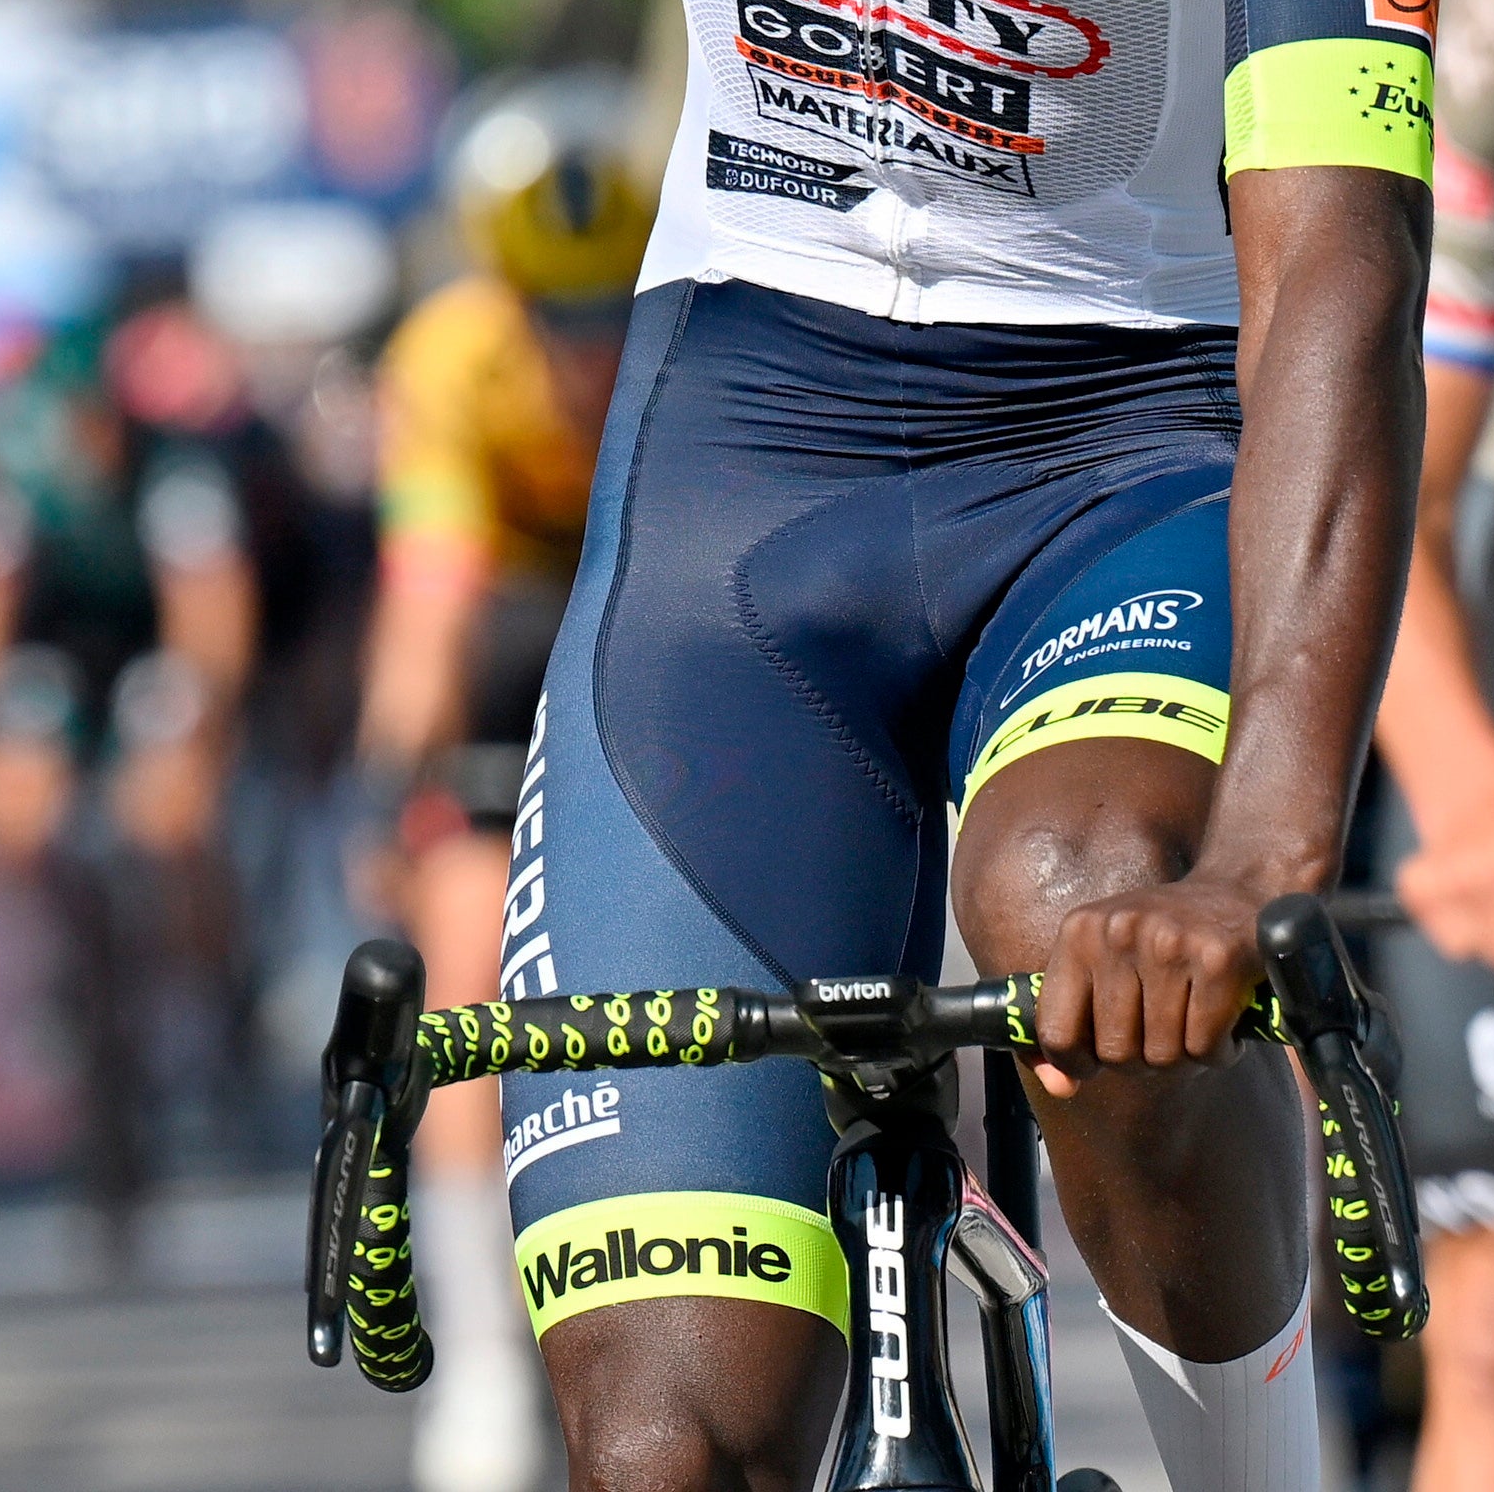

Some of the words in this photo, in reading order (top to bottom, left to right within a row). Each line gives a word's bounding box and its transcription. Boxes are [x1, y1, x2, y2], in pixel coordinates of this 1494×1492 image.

[744, 4, 1016, 115] GOBERT
[728, 140, 836, 177] TECHNORD
[758, 78, 1019, 184] MATERIAUX
[740, 171, 838, 205] DUFOUR
[1021, 600, 1180, 680] TORMANS
[1063, 637, 1192, 666] ENGINEERING
[986, 696, 1227, 761] CUBE
[1342, 1083, 1400, 1246] DURA-ACE
[523, 1226, 792, 1311] Wallonie
[865, 1189, 912, 1440] CUBE
